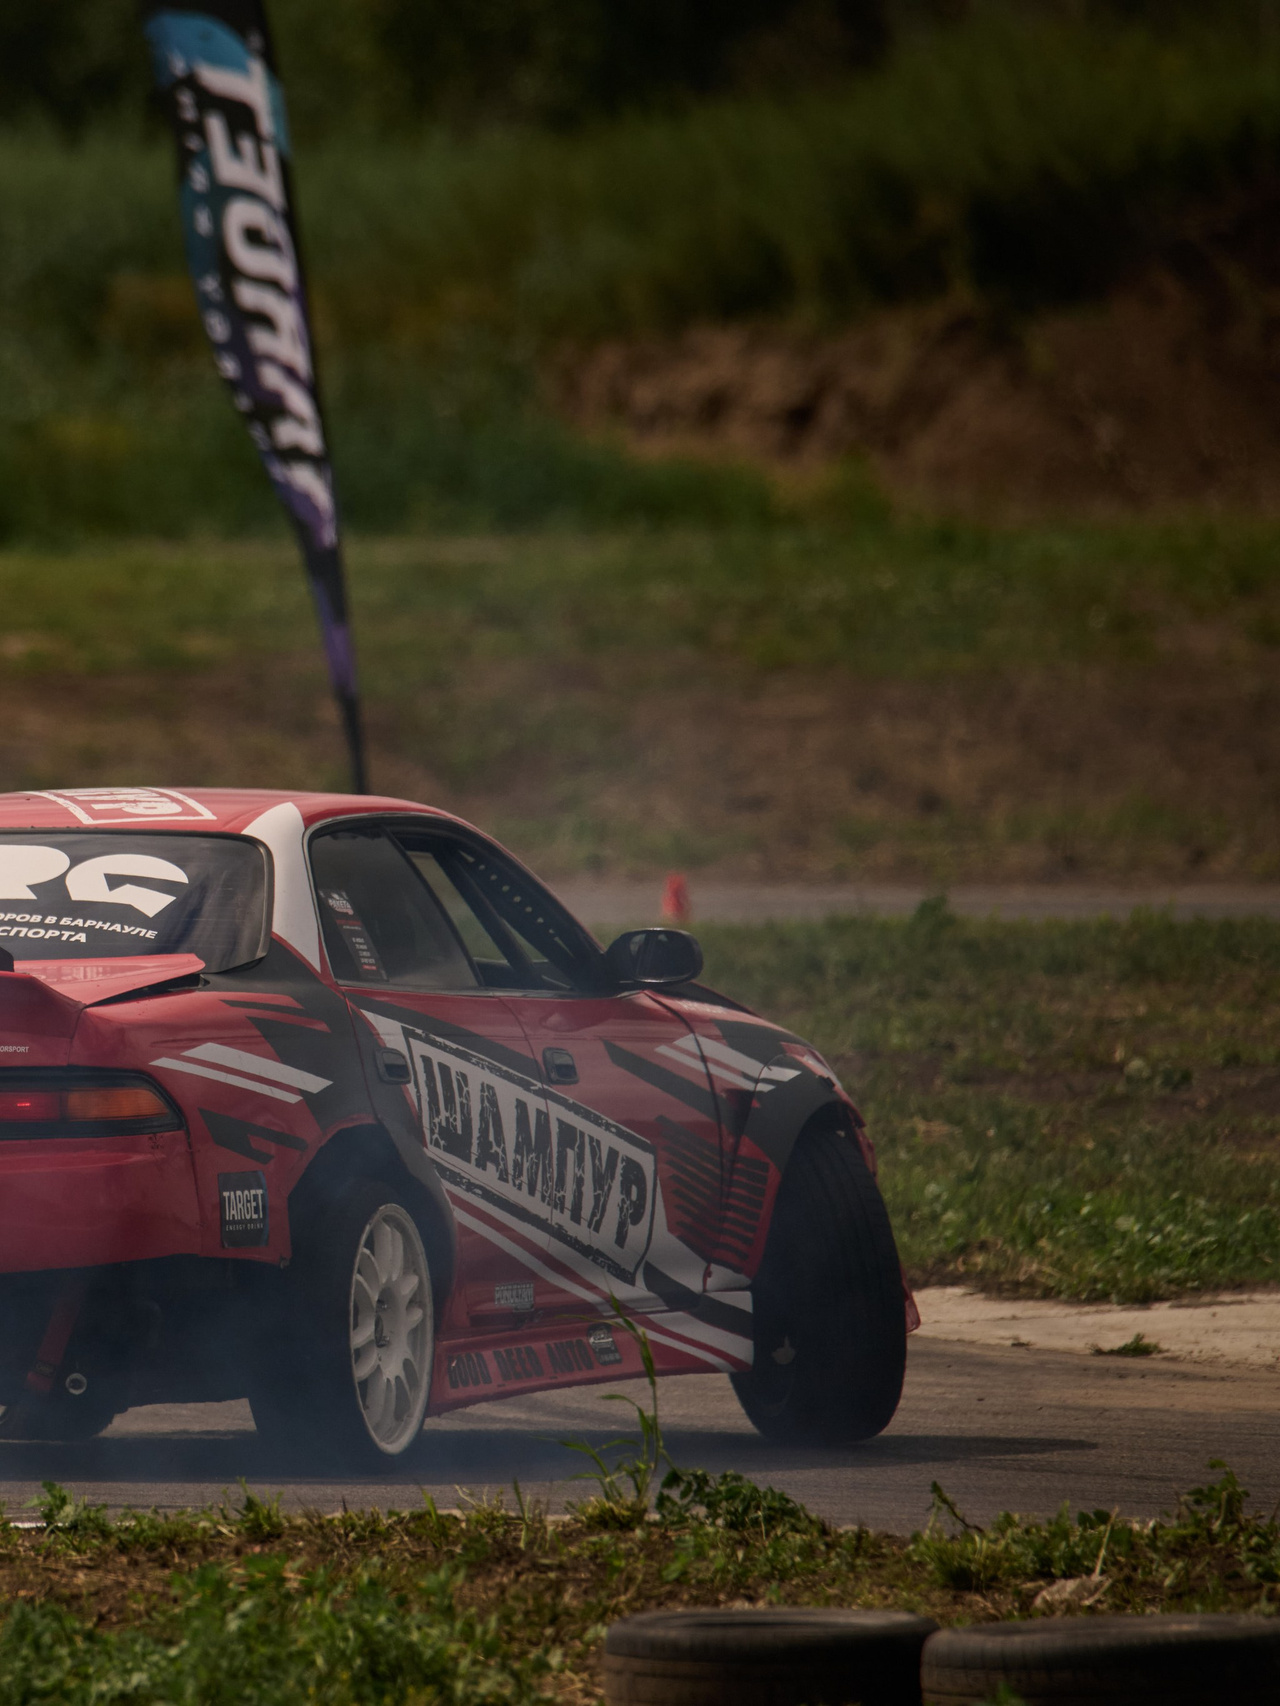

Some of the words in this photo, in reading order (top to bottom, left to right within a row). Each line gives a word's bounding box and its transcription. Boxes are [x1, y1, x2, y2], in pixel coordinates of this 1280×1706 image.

[44, 916, 58, 925] В
[59, 917, 158, 940] БАРНАУЛЕ
[420, 1054, 647, 1249] ШАМПУР
[223, 1189, 263, 1220] TARGET
